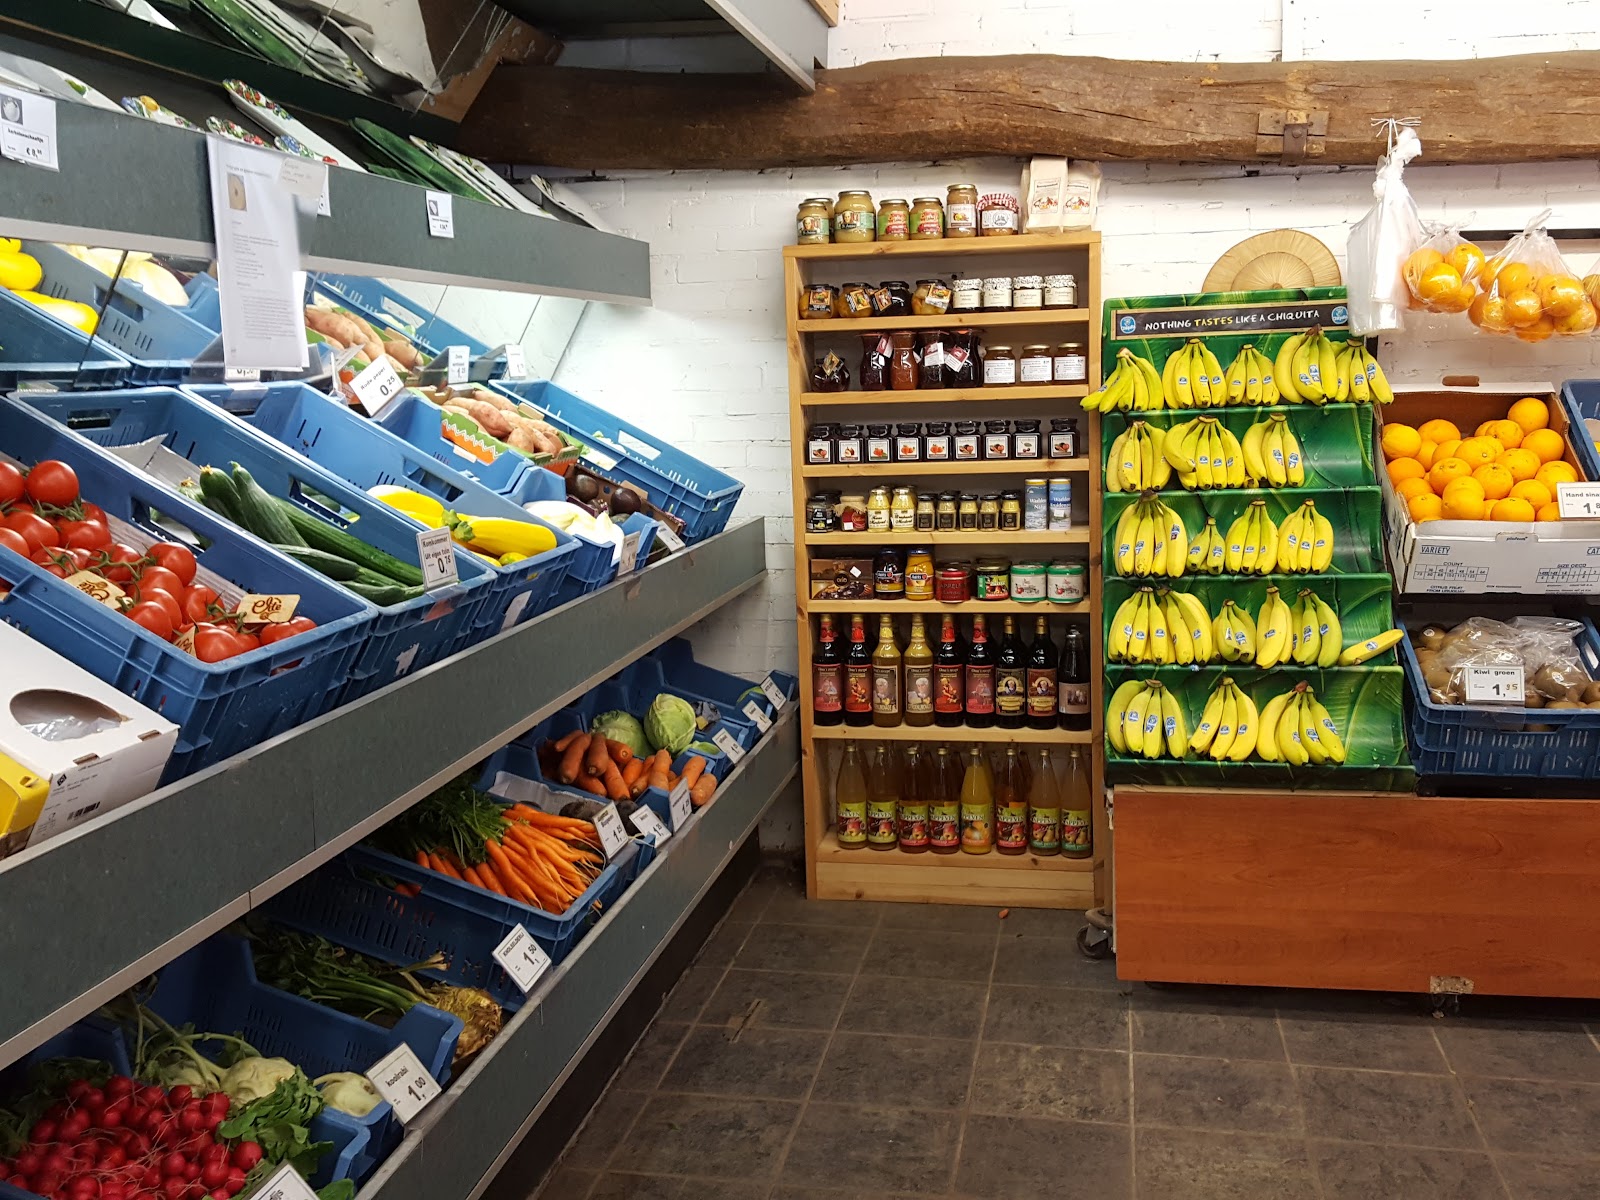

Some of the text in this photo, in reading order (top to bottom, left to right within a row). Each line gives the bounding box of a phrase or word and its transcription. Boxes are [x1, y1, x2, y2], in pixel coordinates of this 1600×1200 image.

[1145, 310, 1320, 331] NOTHING TASTES LIKE A CHIQUITA
[380, 376, 396, 396] 0,25
[1583, 502, 1600, 515] 1,8
[422, 536, 448, 547] Komkommer
[1421, 545, 1450, 555] VARIETY
[438, 555, 451, 574] 0,75
[523, 943, 540, 965] 1,50
[385, 1065, 409, 1087] koolrabi
[408, 1076, 426, 1101] 1,00
[269, 1189, 284, 1200] dijs
